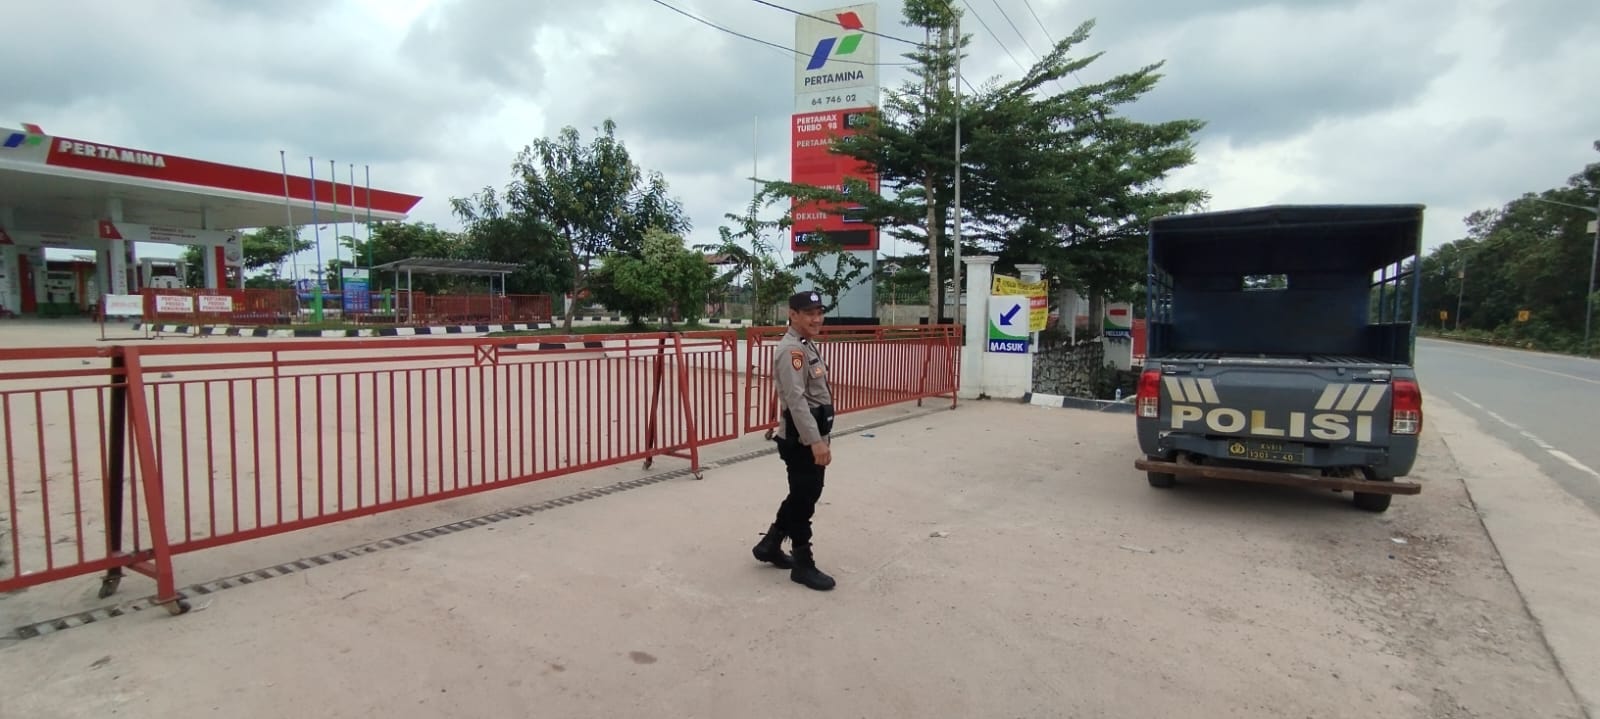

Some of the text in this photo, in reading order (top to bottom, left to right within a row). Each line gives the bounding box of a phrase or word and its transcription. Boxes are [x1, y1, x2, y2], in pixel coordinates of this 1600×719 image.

[805, 70, 864, 86] PERTAMINA
[811, 94, 857, 106] 64 746 02
[797, 114, 837, 125] PERTAMAX
[797, 124, 822, 132] TURBO
[797, 138, 836, 148] PERTAMA
[58, 140, 167, 168] PERTAMINA
[796, 212, 827, 220] DEXLITE
[990, 341, 1024, 351] MASUK
[1170, 404, 1373, 442] POLISI
